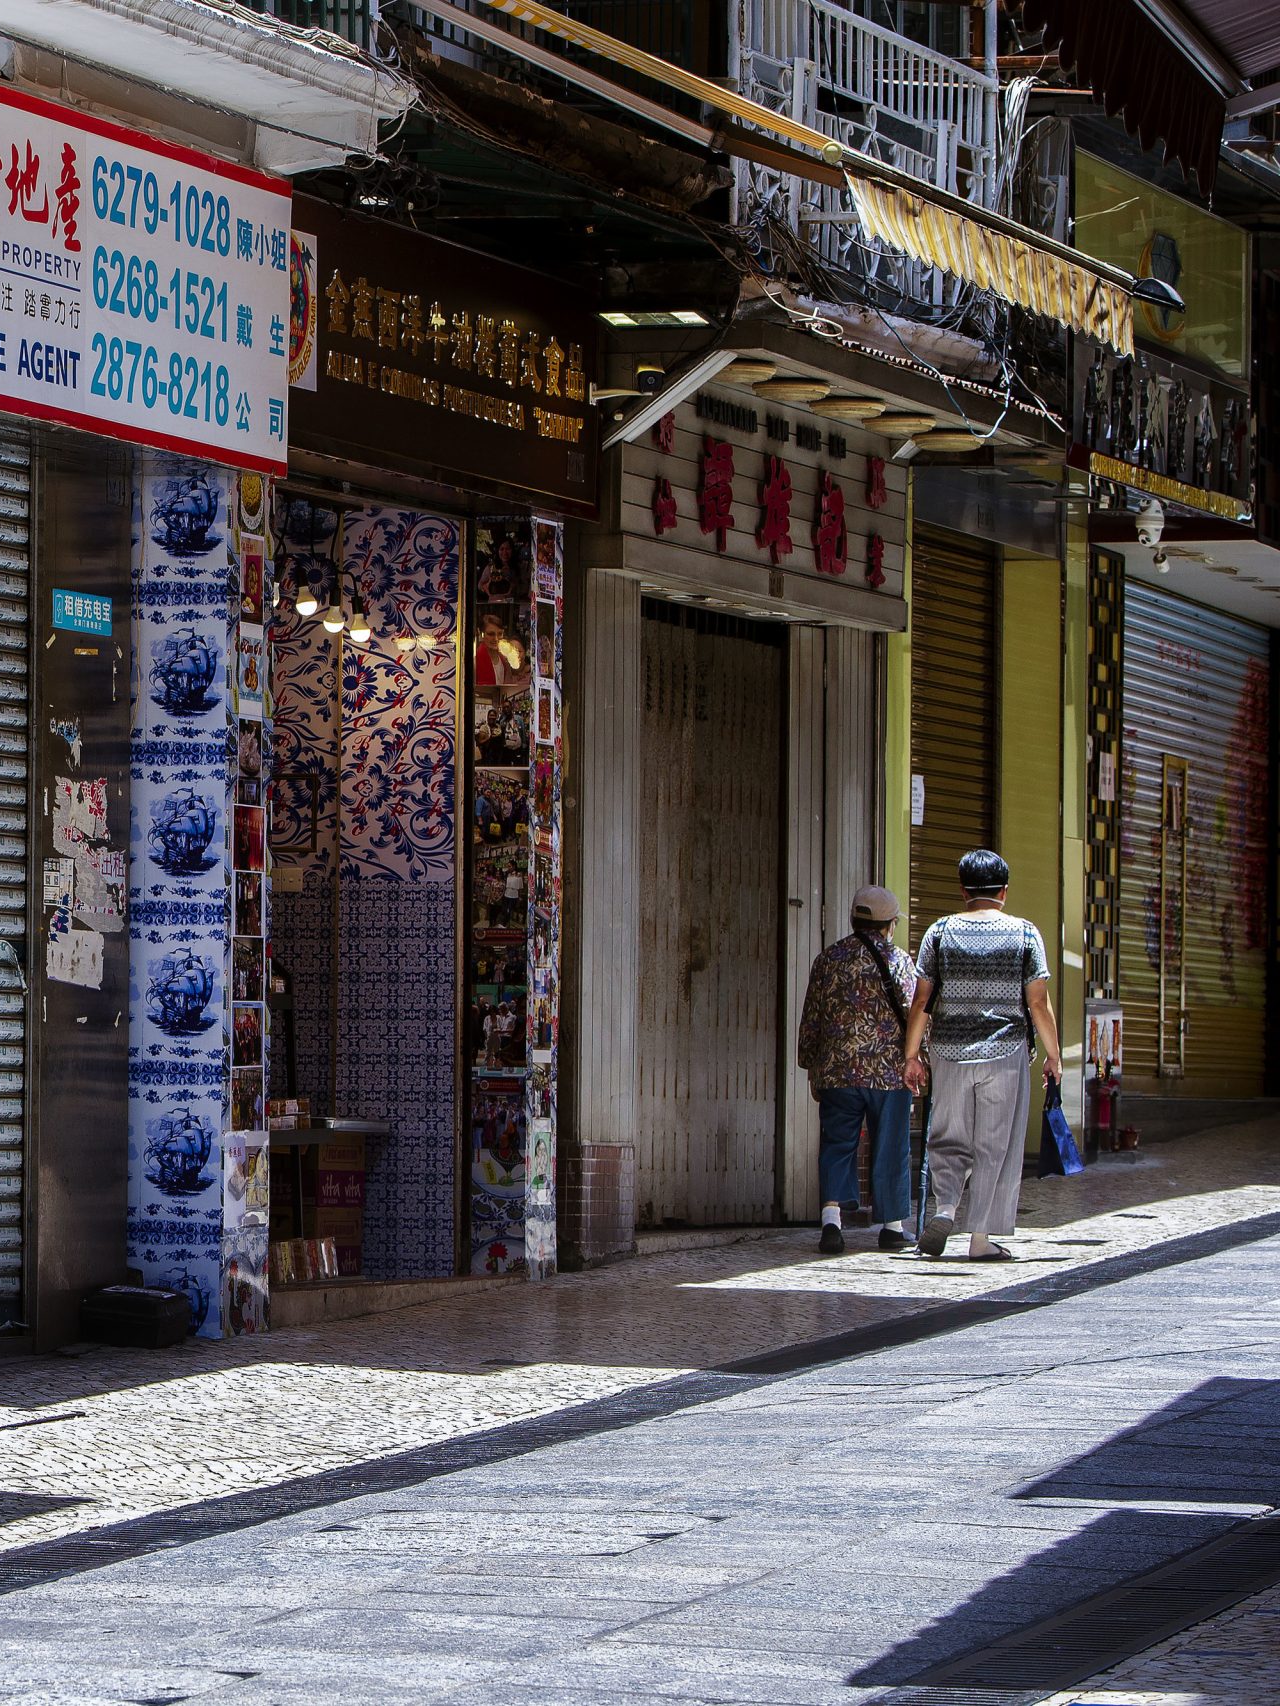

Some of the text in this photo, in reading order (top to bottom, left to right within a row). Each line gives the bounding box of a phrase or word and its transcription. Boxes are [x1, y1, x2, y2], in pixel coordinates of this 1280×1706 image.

[92, 155, 287, 274] 6279-1028 陳小姐
[2, 240, 81, 281] PROPERTY
[92, 246, 228, 343] 6268-1521
[17, 338, 81, 389] AGENT
[91, 332, 229, 427] 2876-8218
[368, 360, 377, 389] E
[443, 383, 525, 431] PORTUGUESA
[64, 595, 111, 622] 租借充电宝
